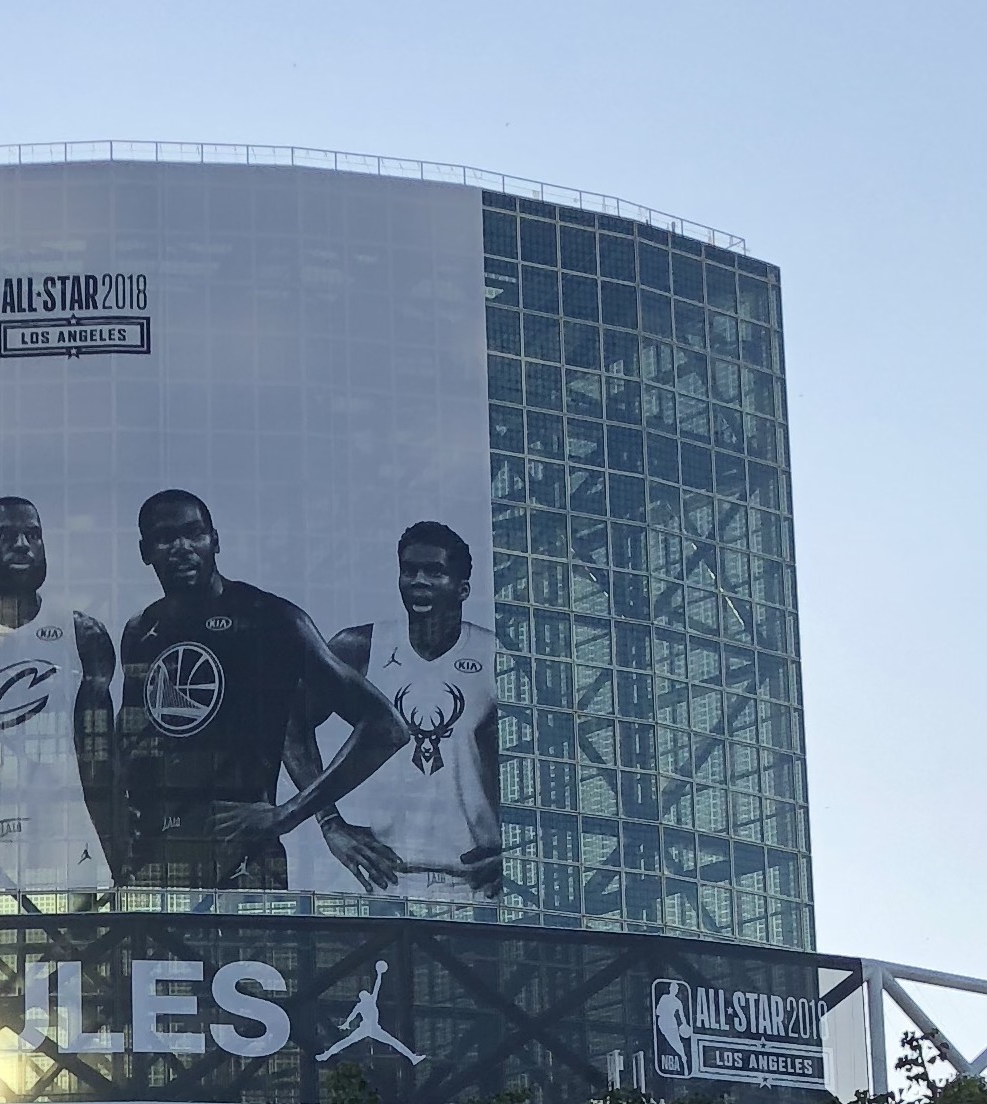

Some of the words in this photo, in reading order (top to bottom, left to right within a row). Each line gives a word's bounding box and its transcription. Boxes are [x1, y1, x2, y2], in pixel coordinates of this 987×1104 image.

[101, 273, 148, 311] 2018
[21, 330, 50, 345] LOS
[57, 328, 127, 344] ANGELES
[661, 1054, 680, 1072] NBA
[715, 1050, 743, 1068] LOS
[748, 1054, 813, 1075] ANGELES
